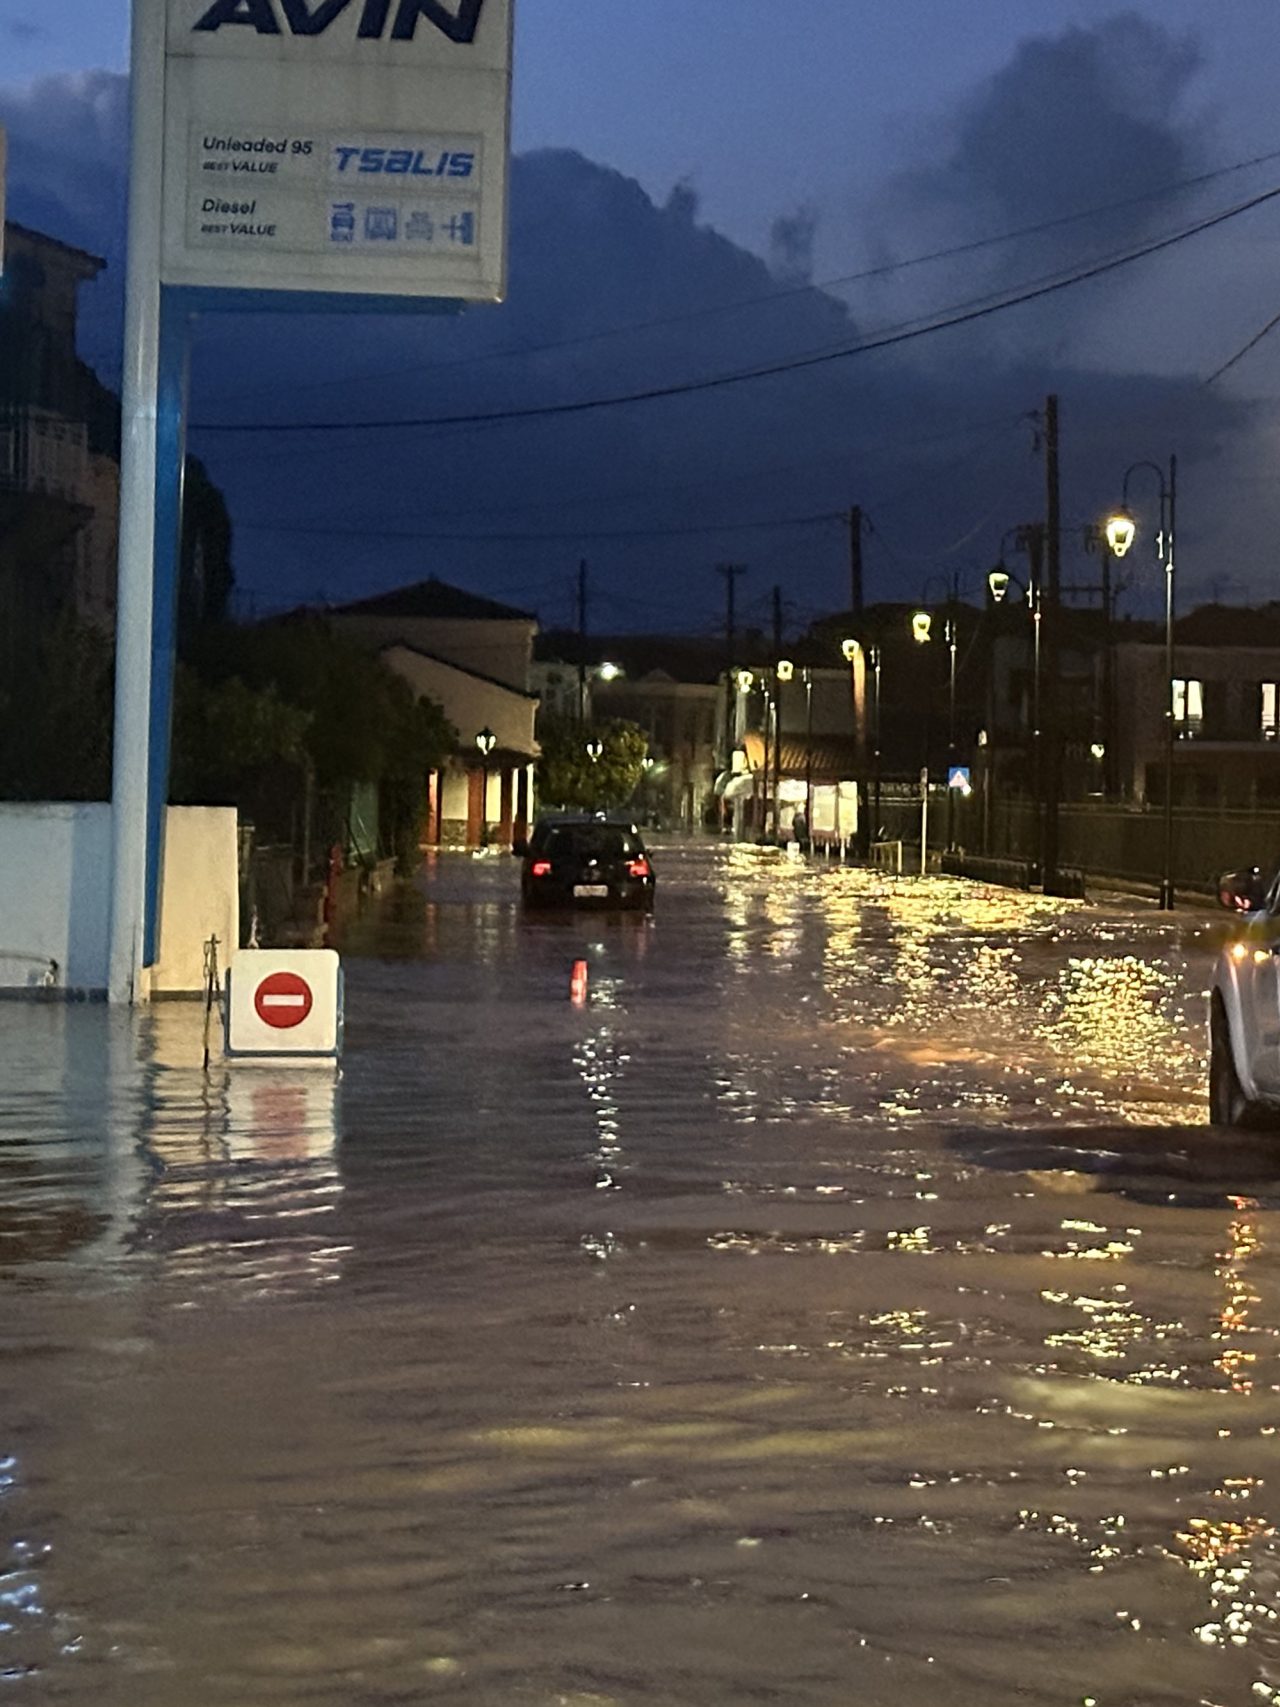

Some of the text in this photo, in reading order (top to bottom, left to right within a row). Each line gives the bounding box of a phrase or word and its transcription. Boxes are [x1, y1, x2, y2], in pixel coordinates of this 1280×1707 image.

[191, 0, 484, 44] AVIN
[203, 137, 313, 155] Unleaded 95
[232, 160, 279, 173] VALUE
[336, 147, 475, 177] TSALIS
[202, 199, 256, 214] Diesel
[230, 223, 277, 236] VALUE
